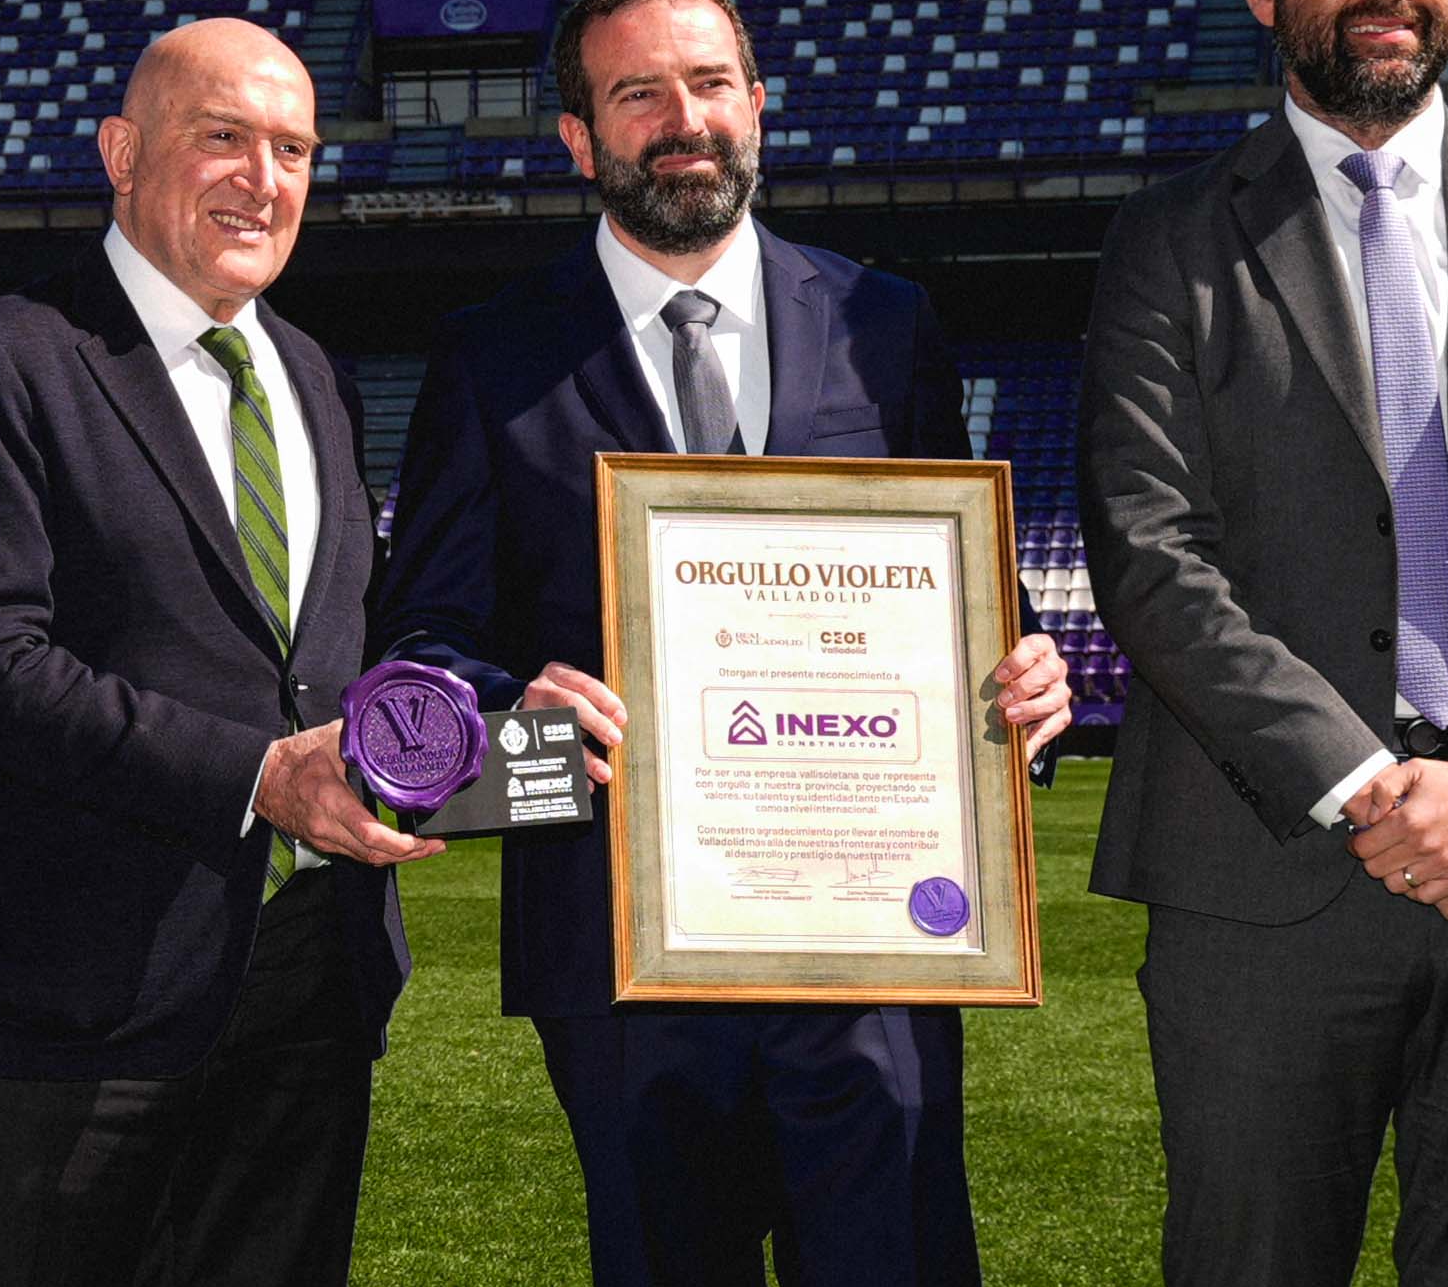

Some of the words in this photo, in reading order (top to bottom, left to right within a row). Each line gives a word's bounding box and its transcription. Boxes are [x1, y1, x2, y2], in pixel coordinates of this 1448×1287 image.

[674, 559, 811, 588] ORGULLO
[815, 563, 937, 590] VIOLETA
[744, 589, 873, 604] VALLADOLID
[820, 631, 868, 645] CEOE
[821, 646, 868, 656] Valladolid
[718, 667, 758, 681] Otorgan
[759, 668, 769, 678] el
[770, 668, 816, 682] presente
[815, 669, 892, 681] reconocimiento
[775, 713, 898, 739] INEXO
[776, 739, 898, 749] CONSTRUCTORA
[695, 767, 711, 777] Por
[733, 770, 751, 778] una
[753, 770, 797, 781] empresa
[799, 769, 860, 780] vallisoletana
[862, 773, 881, 783] que
[883, 771, 937, 784] representa
[763, 780, 802, 790] nuestra
[855, 782, 916, 795] proyectando
[808, 792, 854, 802] identidad
[854, 793, 881, 803] tanto
[696, 825, 717, 834] Con
[717, 825, 755, 835] nuestro
[756, 826, 833, 839] agradecimiento
[833, 829, 851, 840] por
[888, 828, 926, 838] nombre
[927, 829, 940, 839] de
[697, 837, 745, 847] Valladolid
[784, 838, 797, 848] de
[797, 838, 840, 848] nuestras
[840, 839, 886, 849] fronteras
[892, 840, 939, 850] contribuir
[734, 849, 784, 859] desarrollo
[790, 850, 834, 862] prestigio
